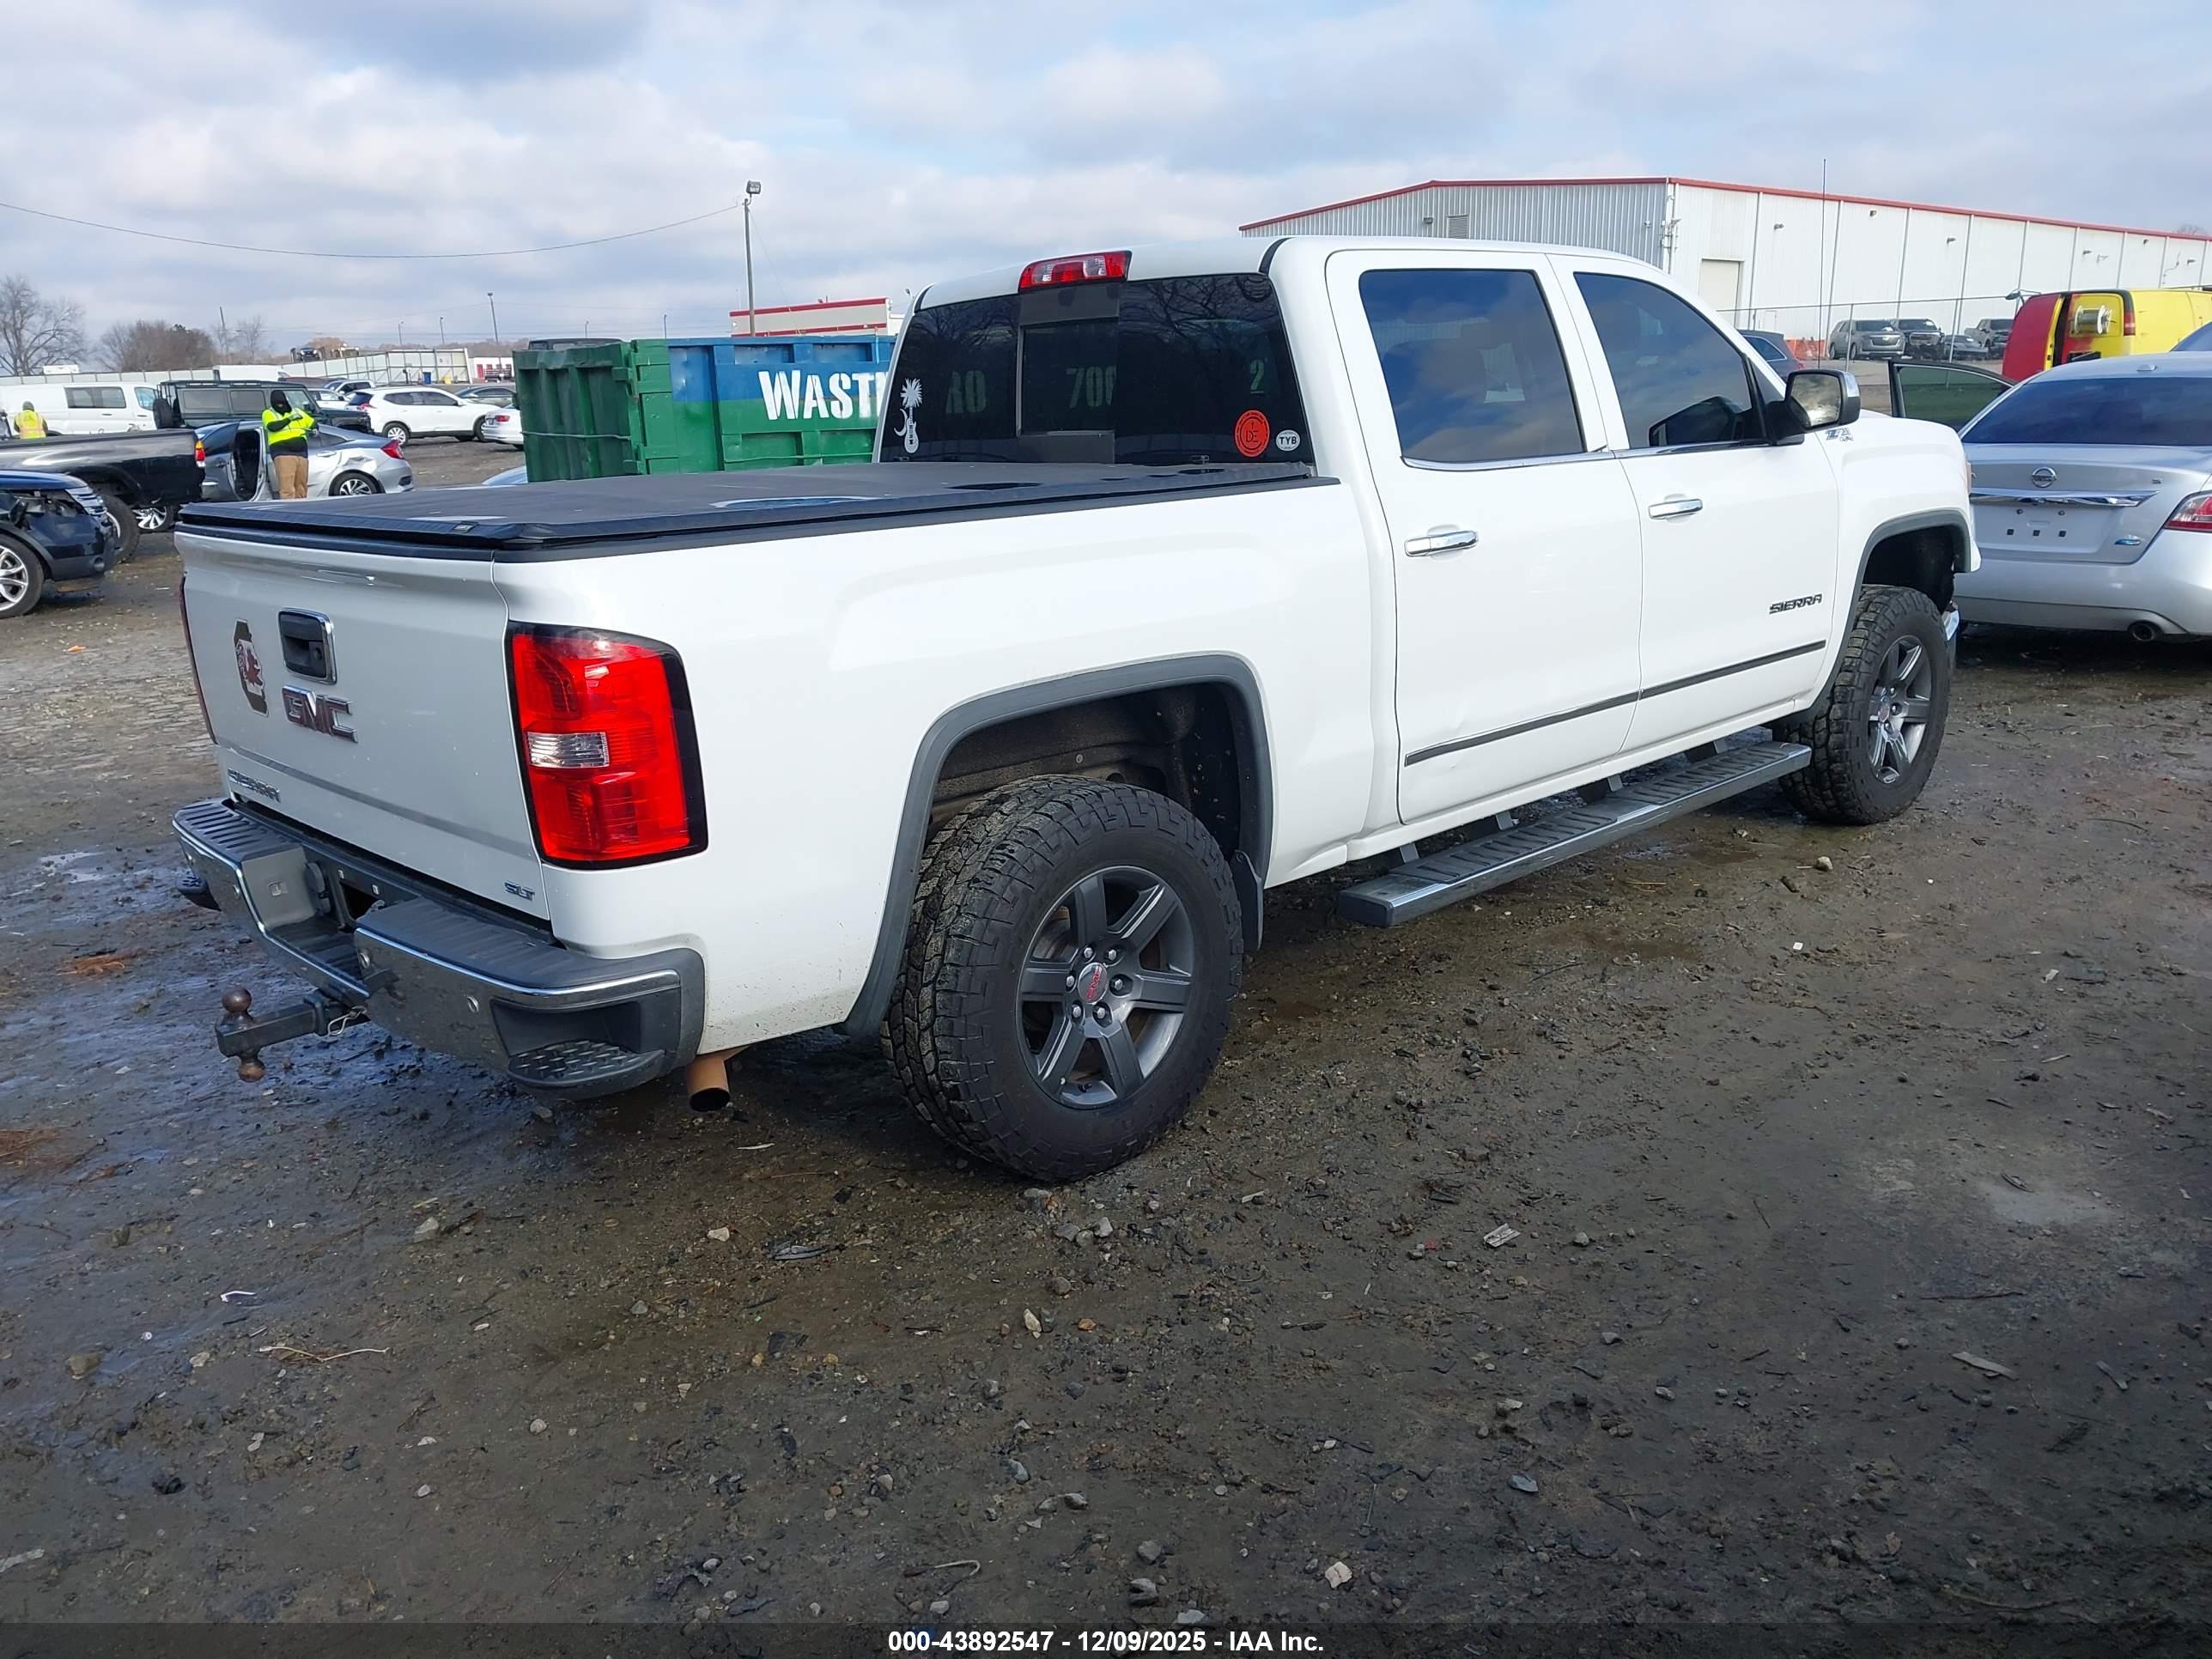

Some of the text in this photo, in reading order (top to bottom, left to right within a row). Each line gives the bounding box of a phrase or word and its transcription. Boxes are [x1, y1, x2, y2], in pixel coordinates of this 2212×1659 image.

[1279, 436, 1297, 445] TYB
[1769, 593, 1822, 615] SIERRA
[282, 684, 358, 744] GMC
[504, 881, 535, 902] SLT
